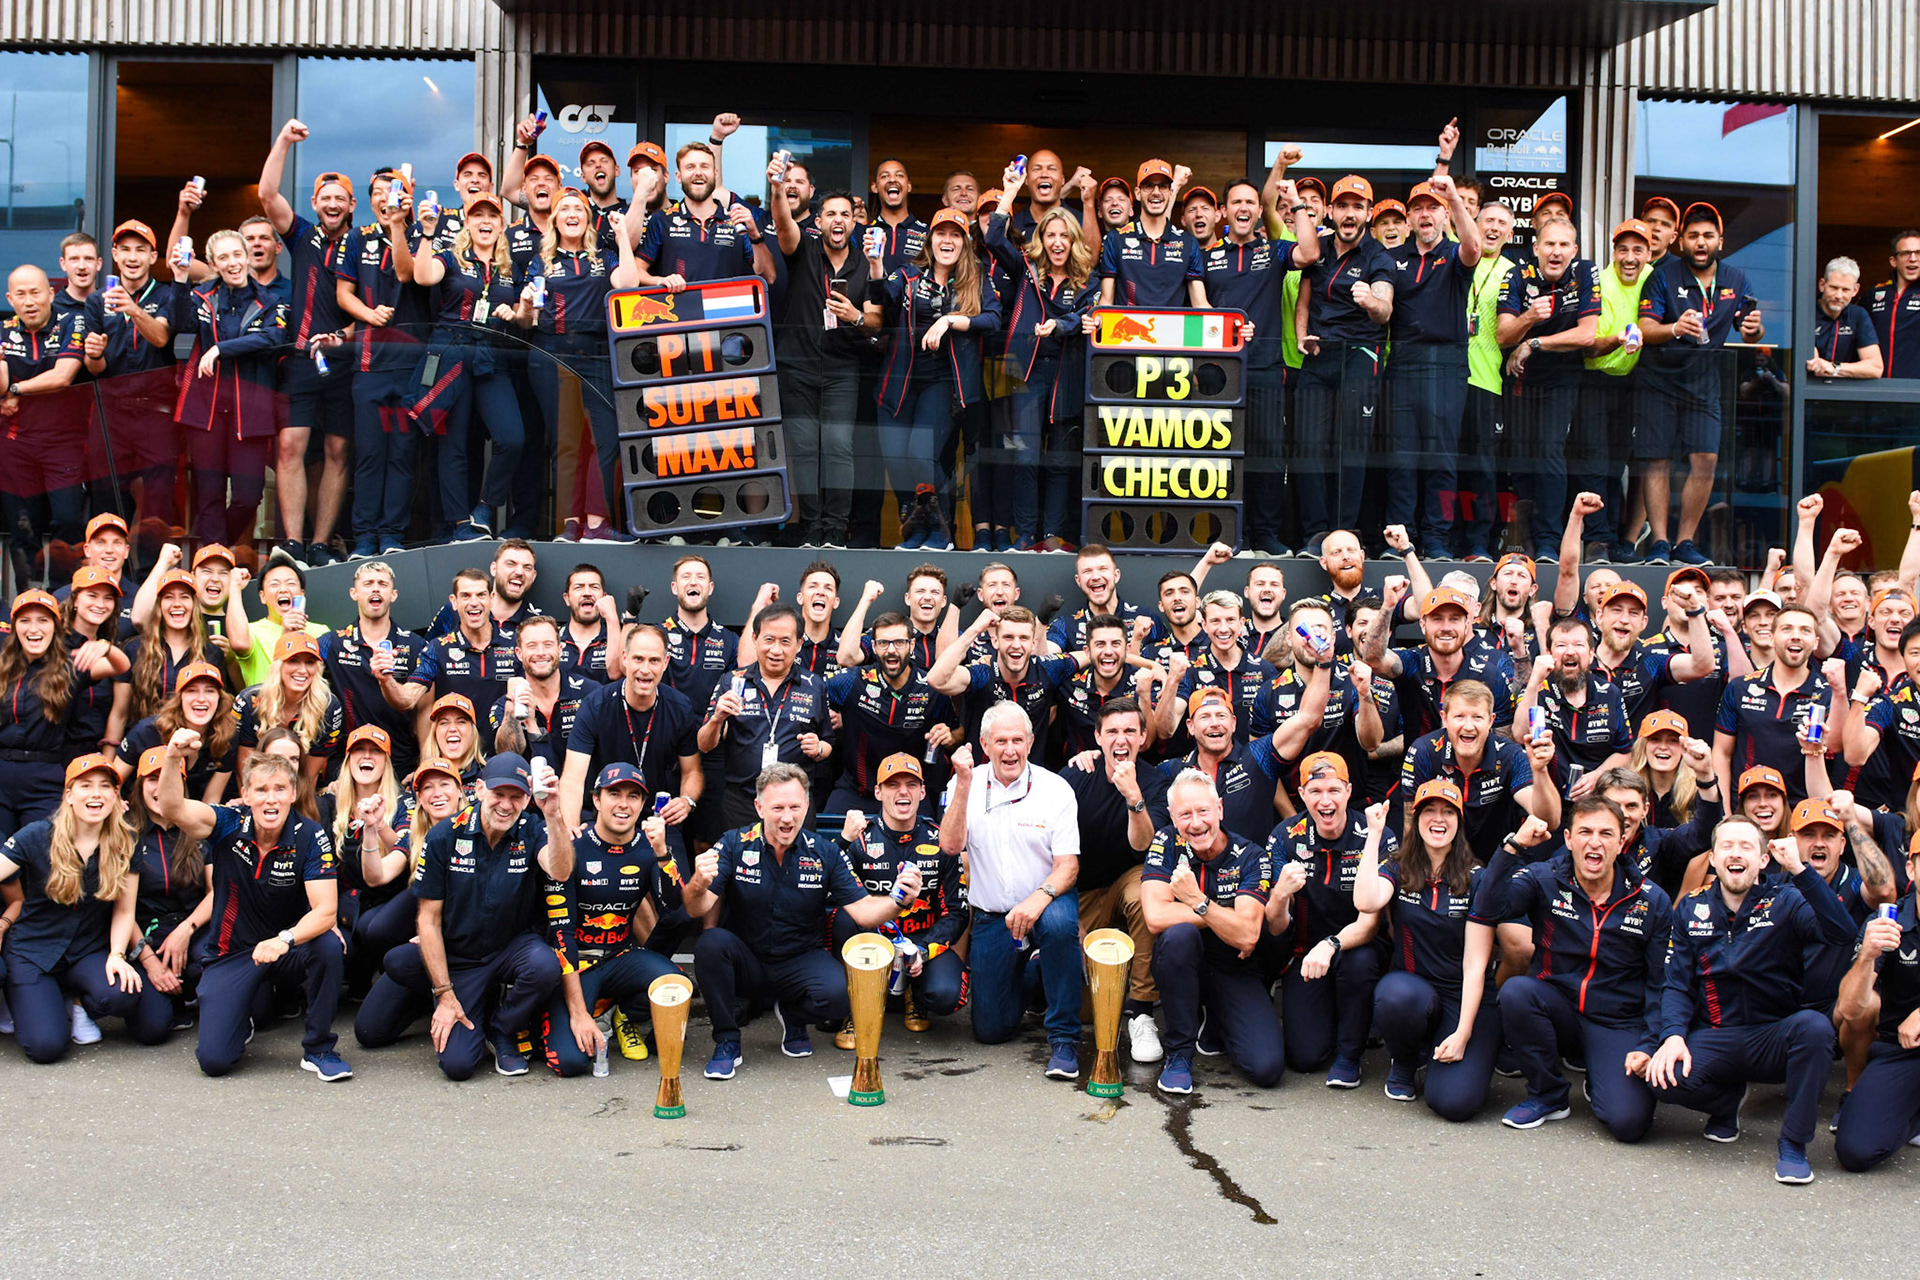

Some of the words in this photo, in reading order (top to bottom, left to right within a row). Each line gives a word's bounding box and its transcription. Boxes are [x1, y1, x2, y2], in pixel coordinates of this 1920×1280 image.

[1487, 129, 1562, 141] ORACLE
[1490, 177, 1557, 188] ORACLE
[646, 383, 761, 428] SUPER
[1100, 407, 1232, 450] VAMOS
[657, 433, 756, 477] MAX!
[1104, 458, 1228, 498] CHECO!
[792, 706, 810, 714] BYBIT
[858, 702, 879, 713] ORACLE
[1325, 703, 1342, 713] BYBIT
[1588, 719, 1608, 727] BYBIT
[1482, 776, 1500, 788] BYBIT
[1480, 786, 1503, 795] HONDA
[1802, 810, 1808, 818] 1
[588, 829, 601, 846] zoom
[736, 866, 754, 876] Mobil
[736, 875, 760, 884] ORACLE
[1218, 883, 1238, 892] BYBIT
[1398, 895, 1420, 904] ORACLE
[1552, 909, 1579, 920] ORACLE
[1620, 925, 1643, 934] HONDA
[574, 928, 605, 943] Red
